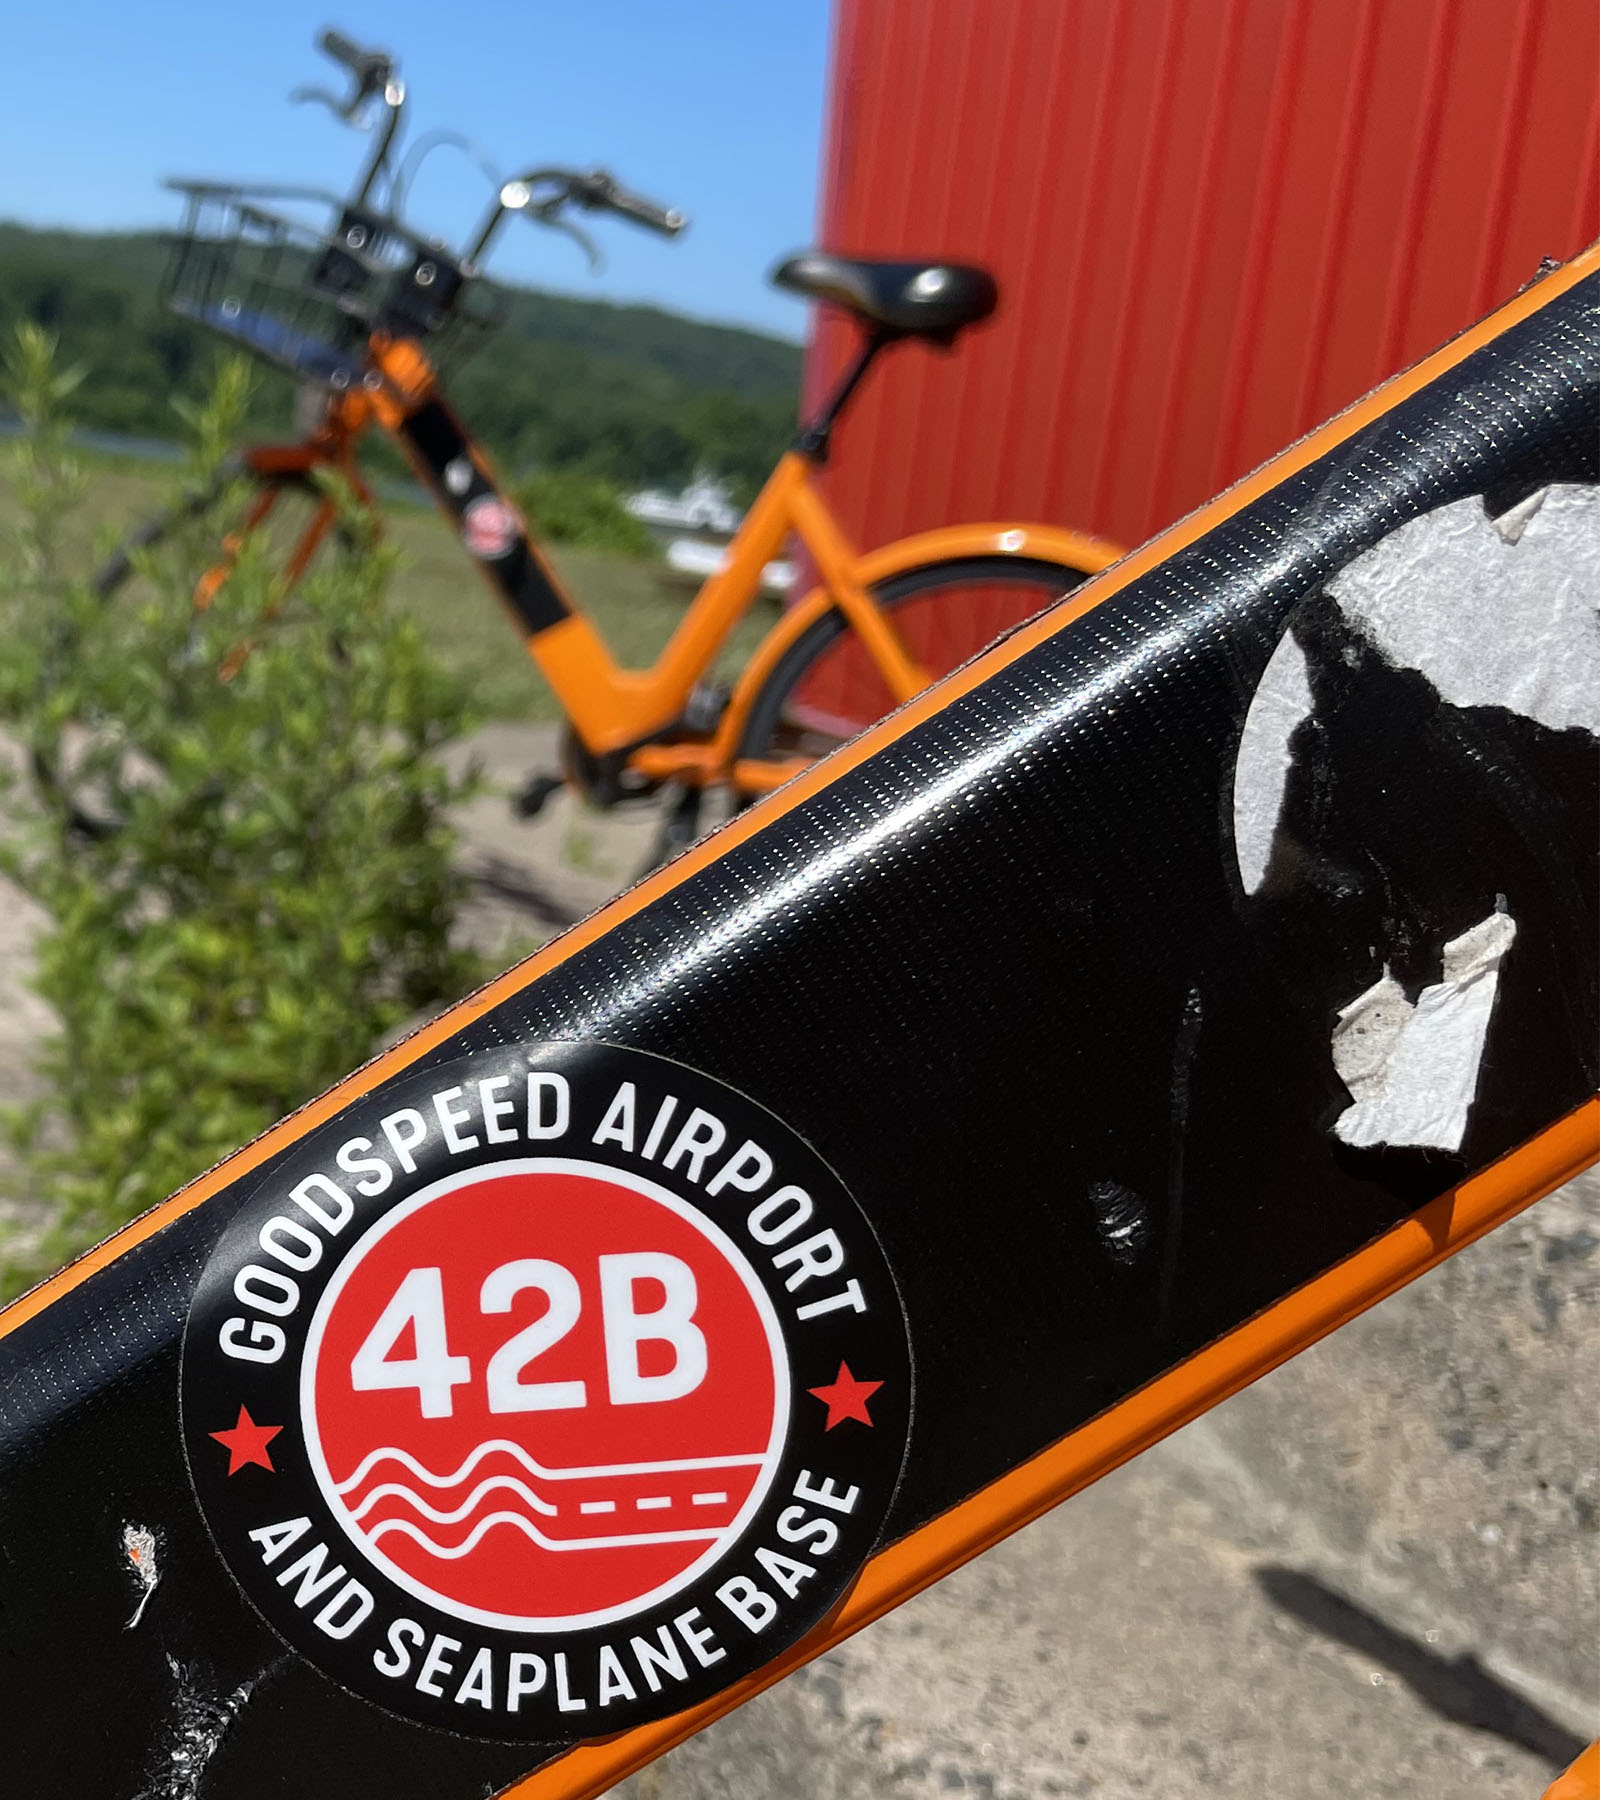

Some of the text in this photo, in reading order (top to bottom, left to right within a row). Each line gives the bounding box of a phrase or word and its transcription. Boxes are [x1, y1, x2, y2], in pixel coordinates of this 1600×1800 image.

[219, 1072, 866, 1364] GOODSPEED AIRPORT
[351, 1252, 708, 1418] 42B
[249, 1470, 859, 1711] AND SEAPLANE BASE
